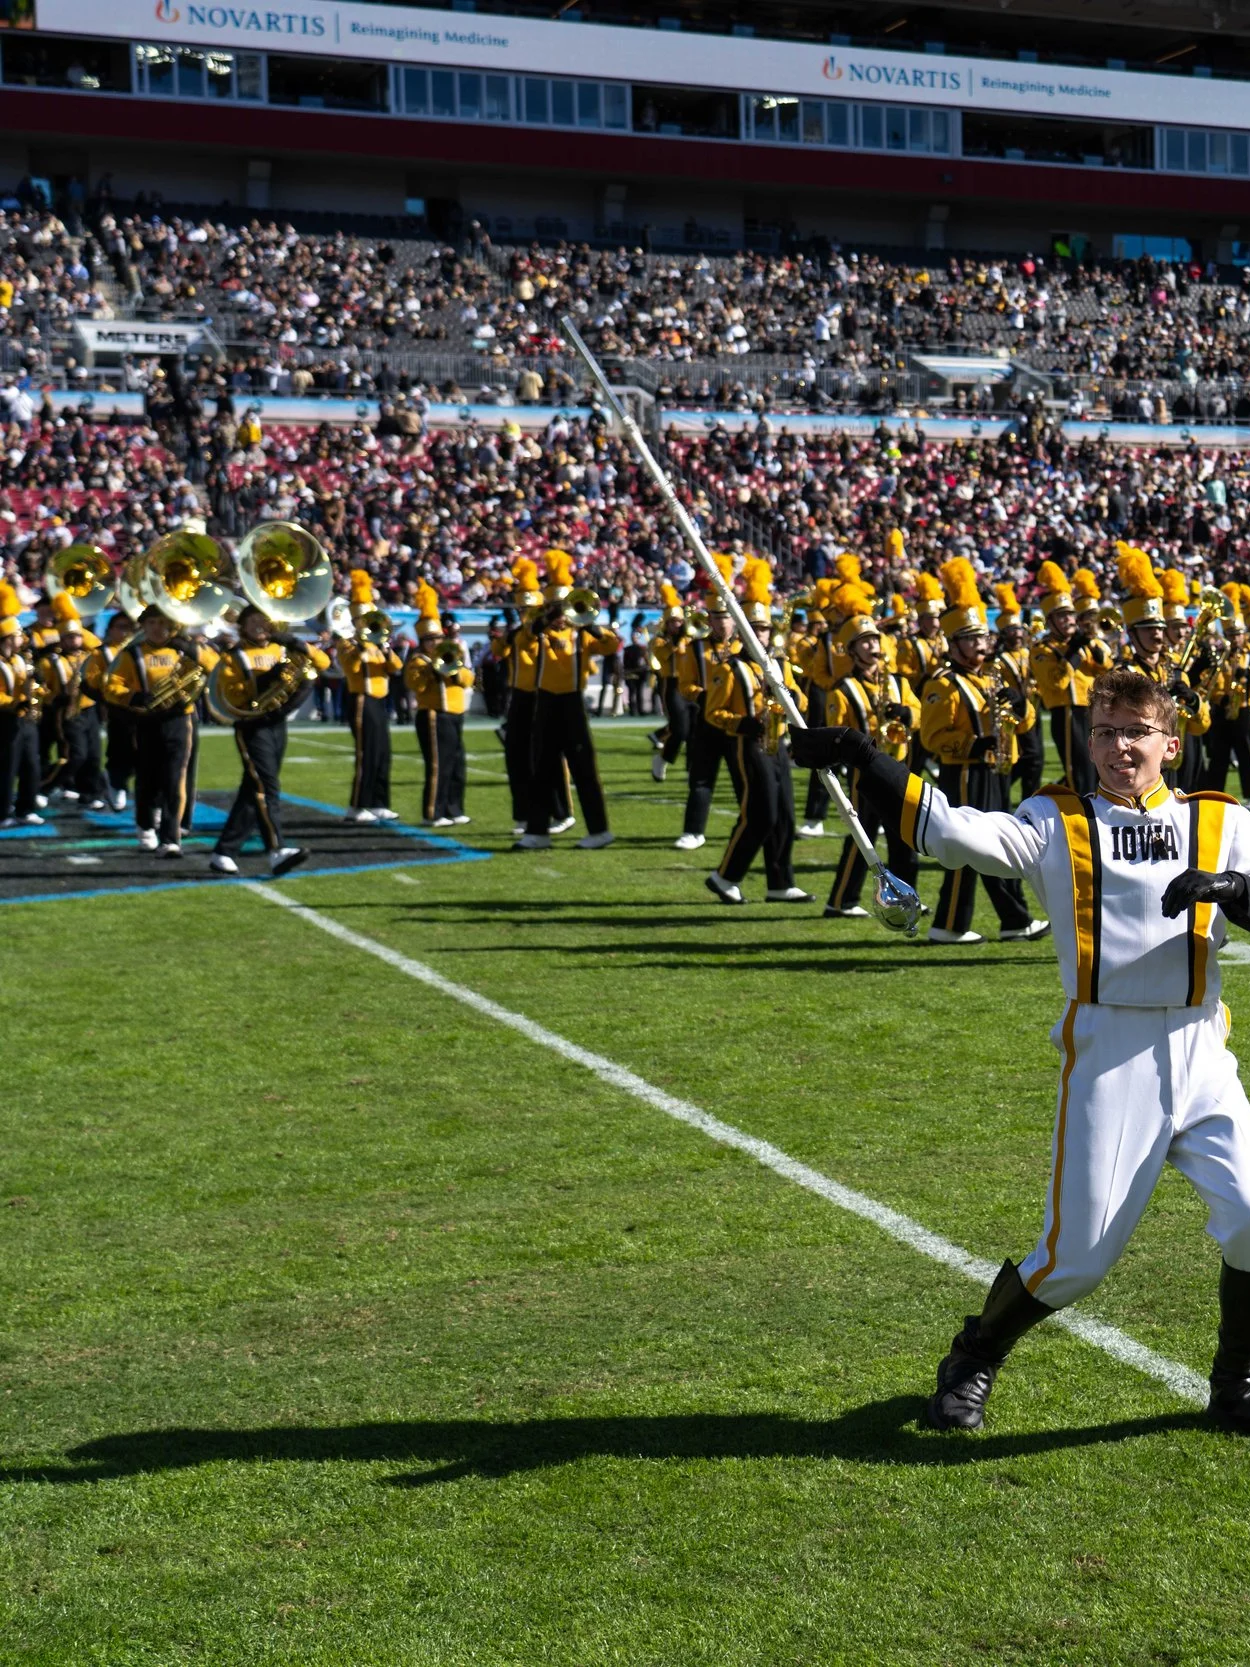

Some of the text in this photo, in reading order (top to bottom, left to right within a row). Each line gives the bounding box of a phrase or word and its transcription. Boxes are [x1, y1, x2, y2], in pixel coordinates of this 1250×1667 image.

[188, 5, 510, 47] NOVARTIS Reimagining Medicine
[848, 64, 1111, 98] NOVARTIS Reimagining Medicine
[97, 331, 187, 344] METERS
[1111, 825, 1179, 861] IOWA
